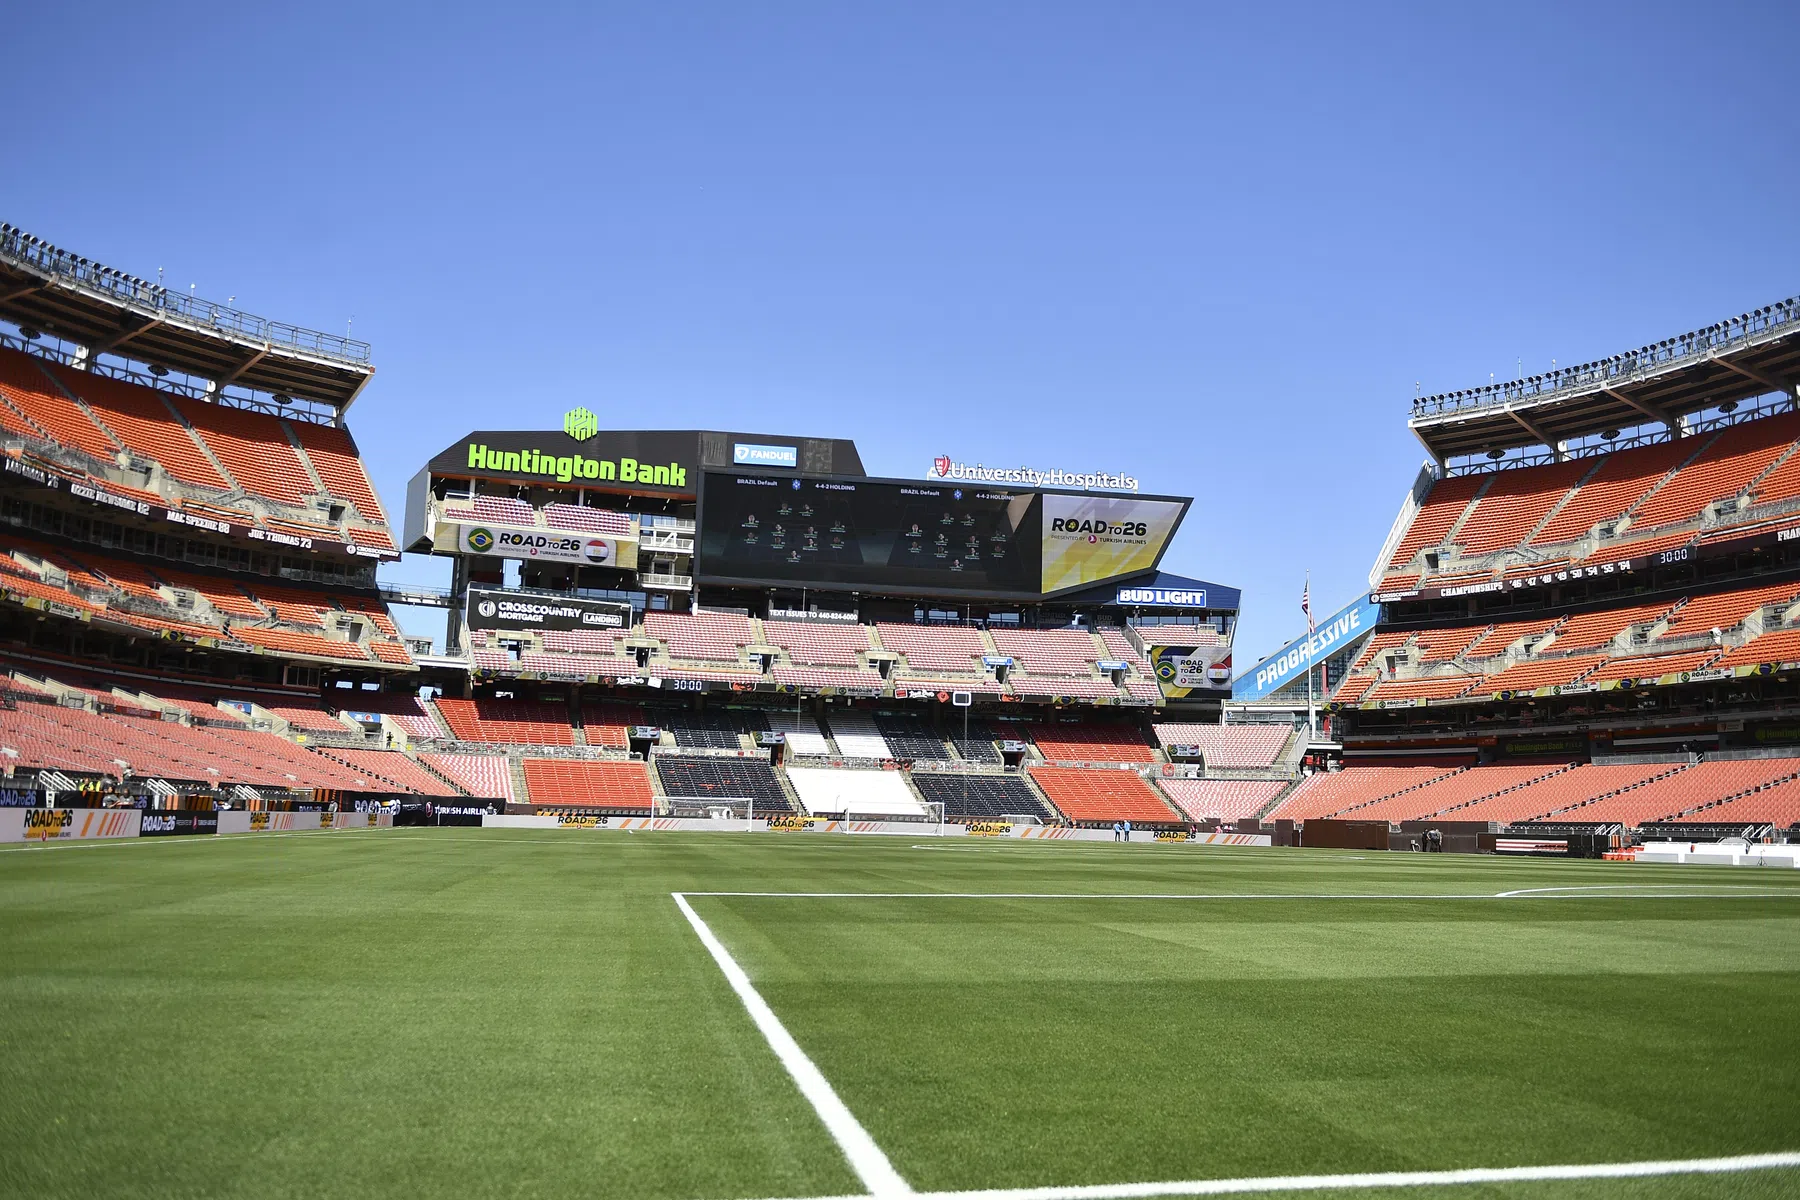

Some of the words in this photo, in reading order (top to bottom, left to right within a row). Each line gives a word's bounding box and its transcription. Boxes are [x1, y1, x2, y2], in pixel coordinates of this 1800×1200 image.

[751, 450, 796, 461] FANDUEL
[467, 443, 615, 483] Huntington
[620, 458, 687, 487] Bank
[951, 461, 1045, 488] University
[1050, 469, 1134, 490] Hospitals
[166, 510, 185, 523] MAC
[1052, 518, 1107, 534] ROAD
[1108, 526, 1122, 535] TO
[248, 528, 265, 540] JOE
[265, 531, 300, 546] THOMAS
[300, 538, 312, 549] 73
[499, 532, 547, 548] ROAD
[548, 541, 560, 550] TO
[1660, 548, 1688, 564] 30:00
[1440, 581, 1504, 598] CHAMPIONSHIPS
[1509, 578, 1522, 588] '46
[1525, 576, 1537, 586] '47
[1540, 574, 1552, 584] '48
[1555, 572, 1568, 582] '49
[1570, 568, 1582, 579] '50
[1585, 566, 1598, 576] '54
[1601, 562, 1614, 574] '55
[1120, 589, 1154, 604] BUD
[1156, 590, 1203, 605] LIGHT
[498, 601, 582, 618] CROSSCOUNTRY
[498, 611, 544, 622] MORTGAGE
[585, 614, 620, 625] LANDING
[1256, 608, 1361, 691] PROGRESSIVE
[674, 680, 702, 690] 30:00
[24, 809, 54, 828] ROAD
[434, 805, 462, 815] TURKISH
[462, 808, 497, 816] AIRLINS
[142, 816, 162, 832] ROAD
[558, 816, 587, 824] ROAD
[965, 824, 992, 832] ROAD
